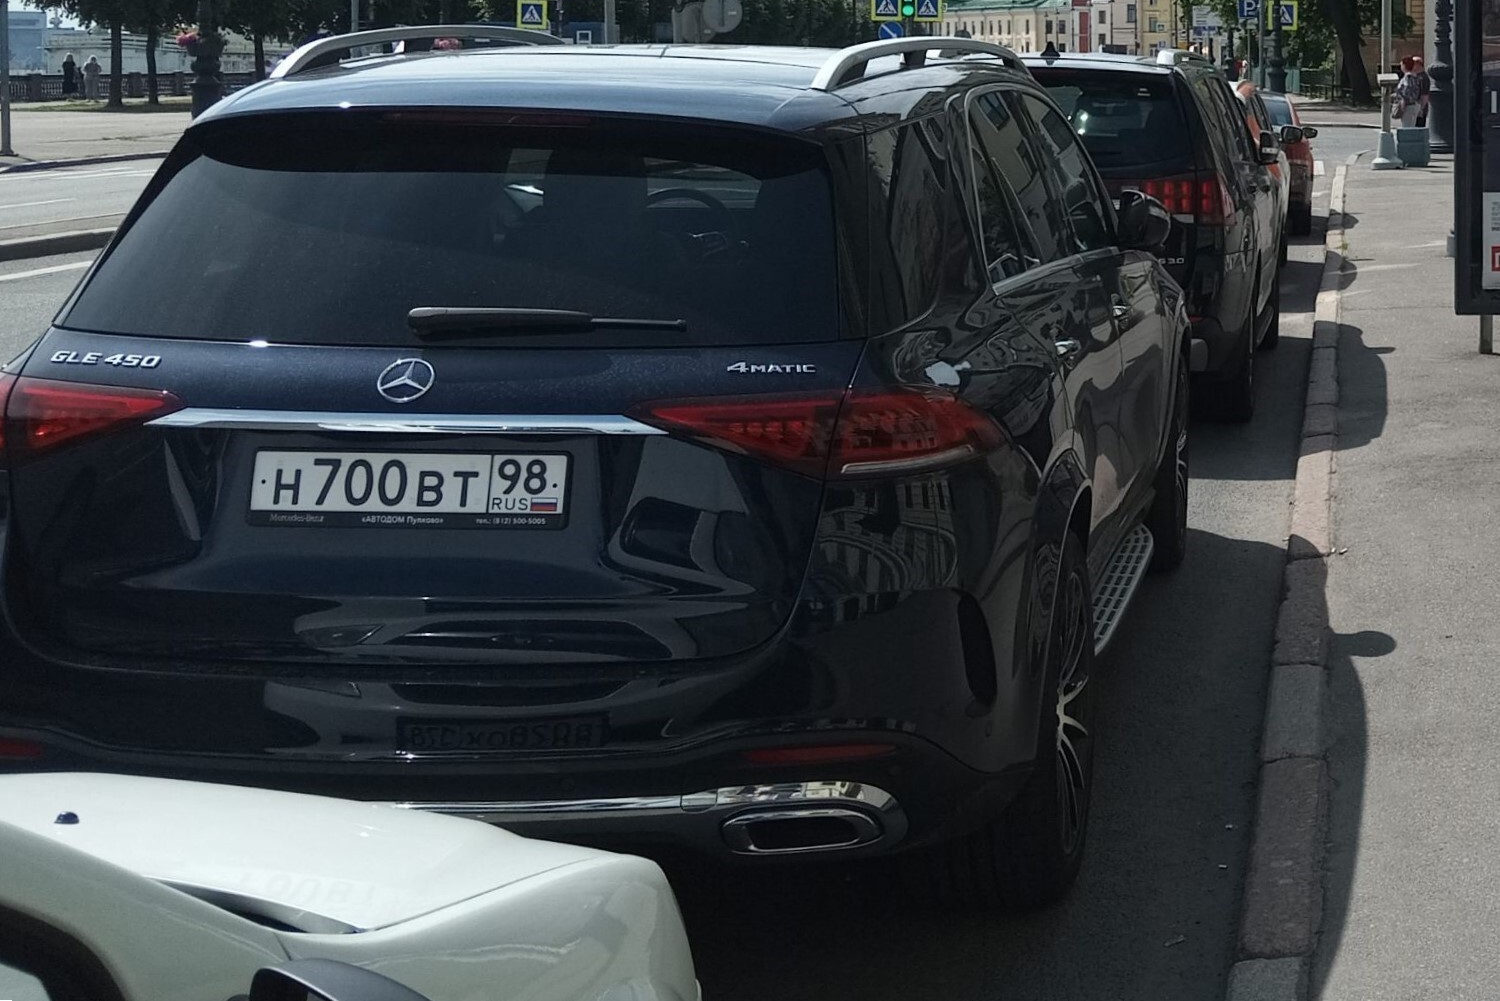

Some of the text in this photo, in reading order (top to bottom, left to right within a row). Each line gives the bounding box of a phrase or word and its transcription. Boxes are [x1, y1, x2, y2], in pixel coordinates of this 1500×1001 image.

[50, 350, 162, 369] GLE 450
[727, 361, 817, 373] 4MATIC
[272, 458, 548, 507] Н700ВТ 98
[491, 497, 529, 511] RUS
